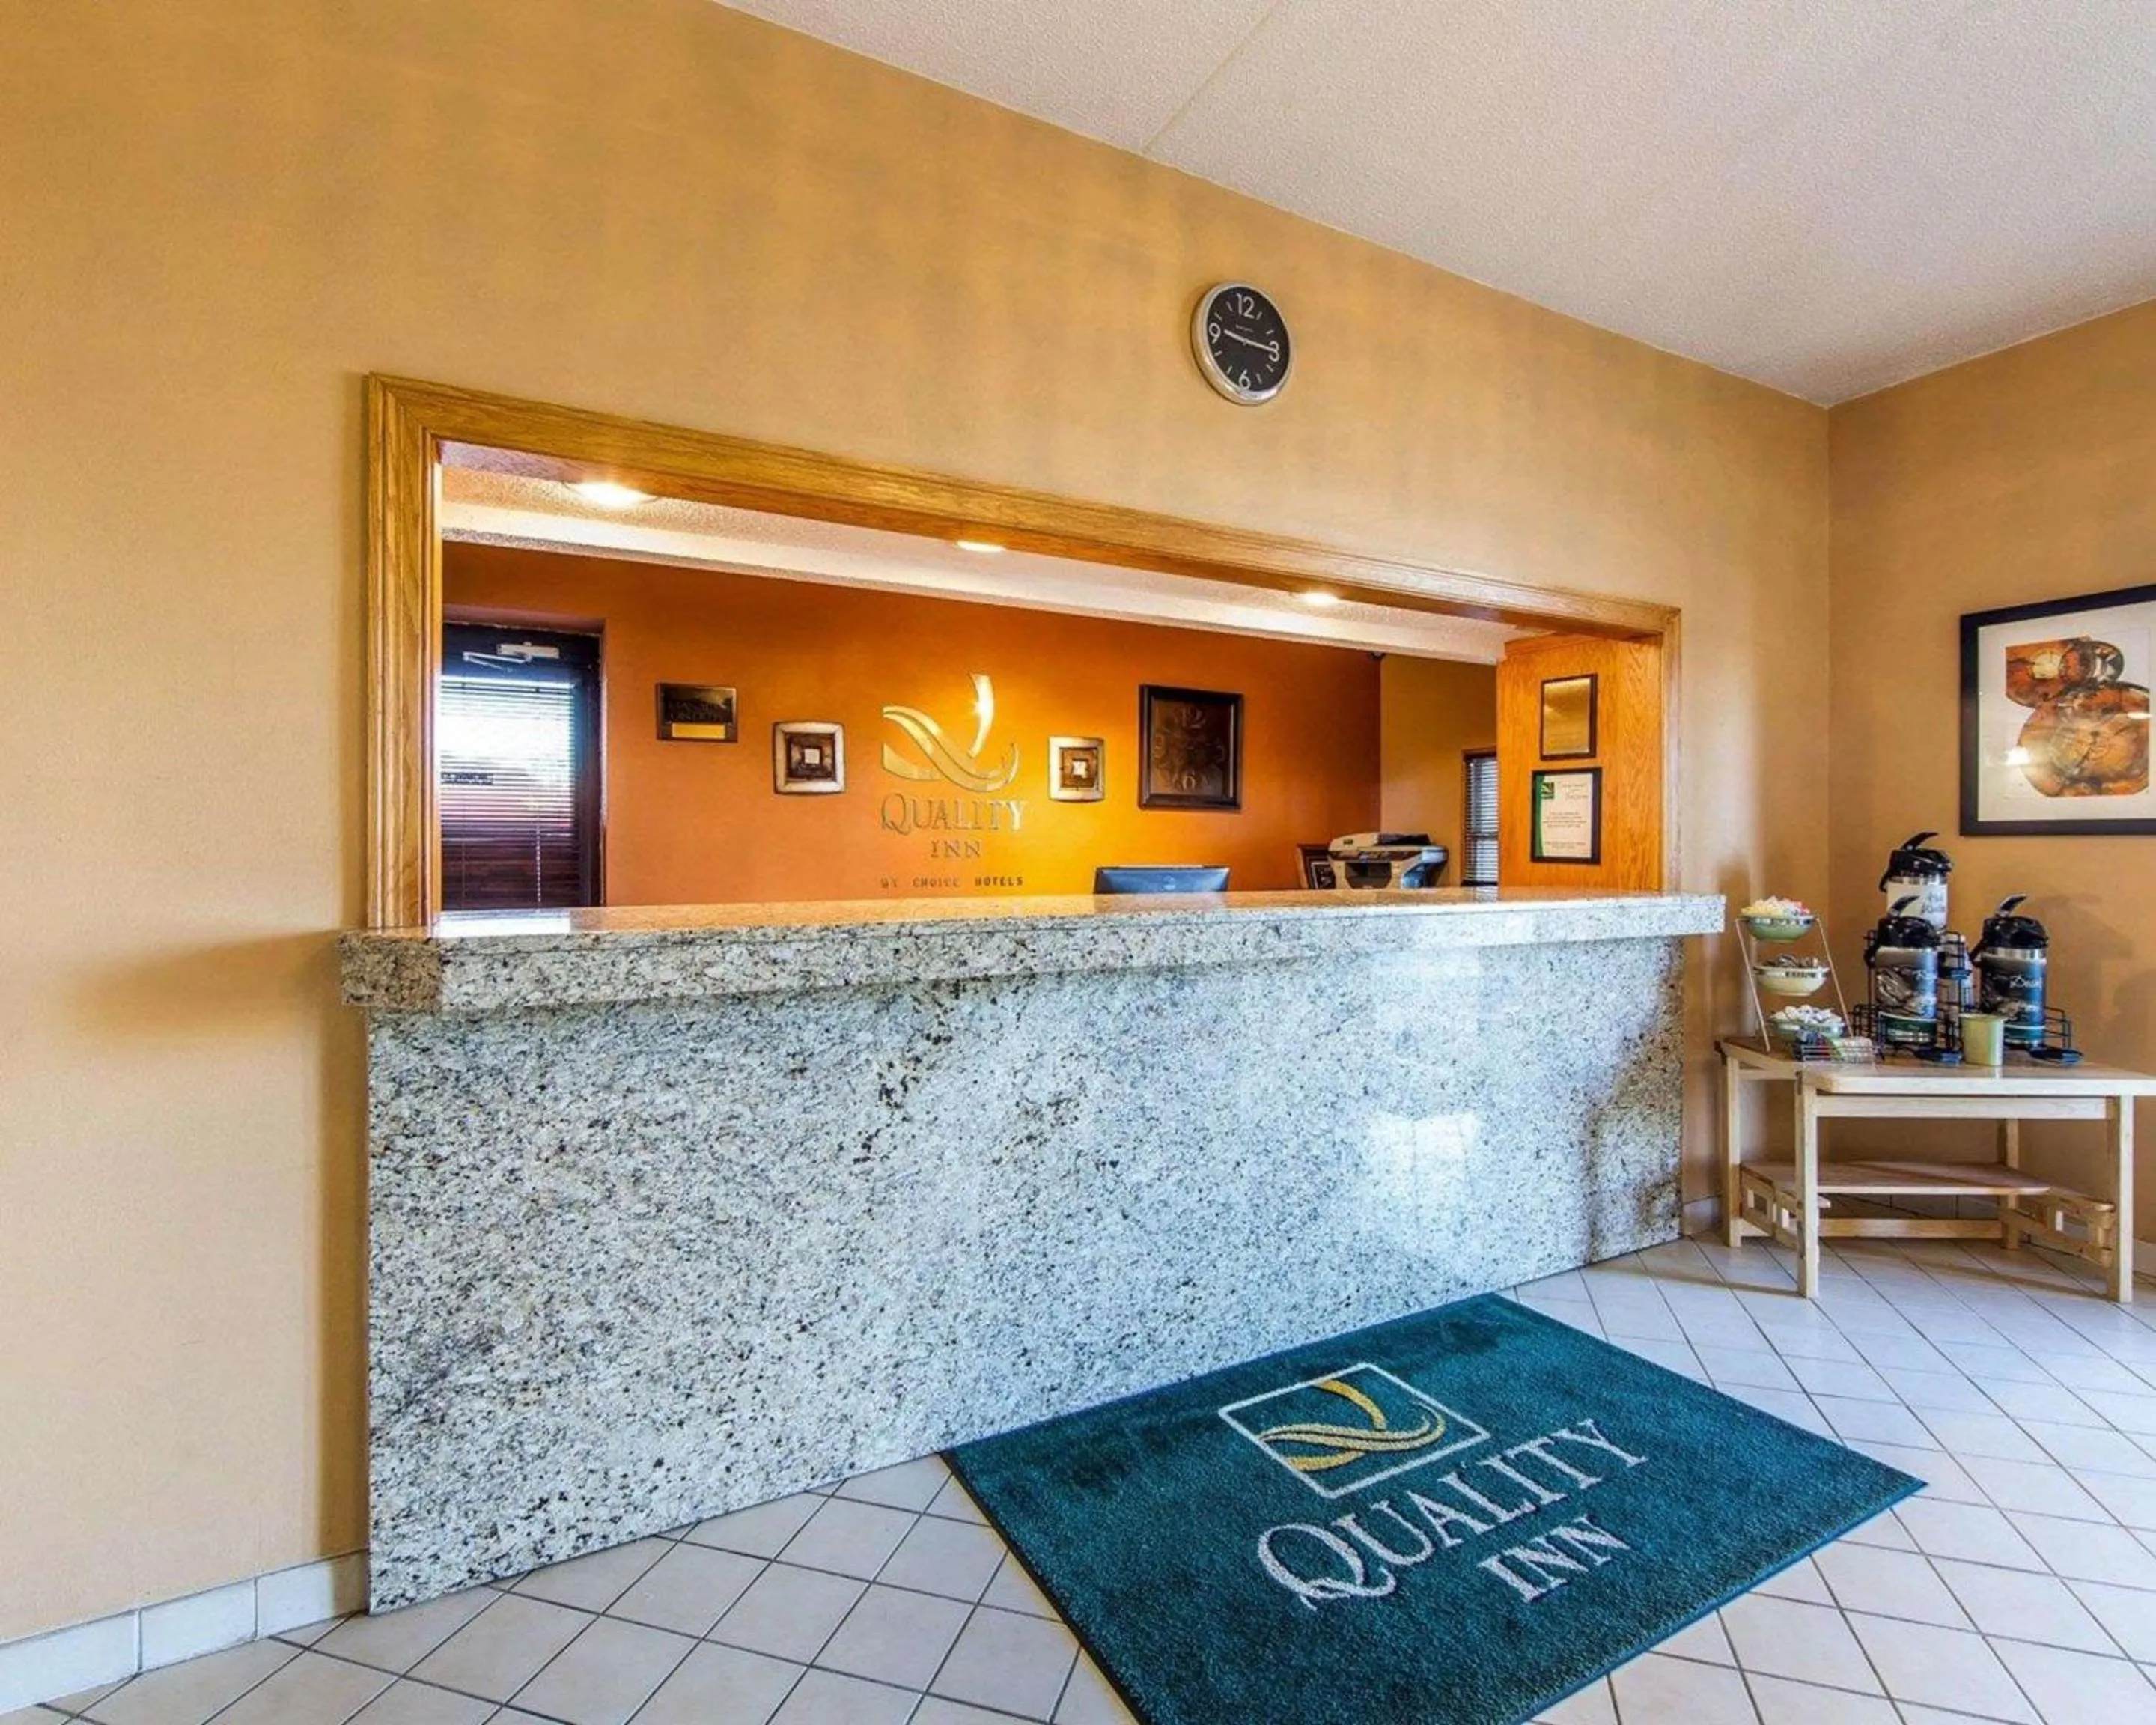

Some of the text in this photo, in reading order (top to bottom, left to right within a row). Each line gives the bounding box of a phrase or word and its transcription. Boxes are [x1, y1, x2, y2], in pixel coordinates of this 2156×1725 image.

[1237, 293, 1255, 319] 12
[1208, 323, 1221, 344] 9
[1268, 341, 1280, 362] 3
[1239, 369, 1251, 389] 6
[880, 792, 1028, 836] QUALITY
[930, 839, 981, 858] INN
[912, 877, 961, 888] CHOICE
[975, 876, 1023, 886] HOTELS
[1258, 1419, 1648, 1611] QUALITY
[1478, 1516, 1631, 1603] INN
